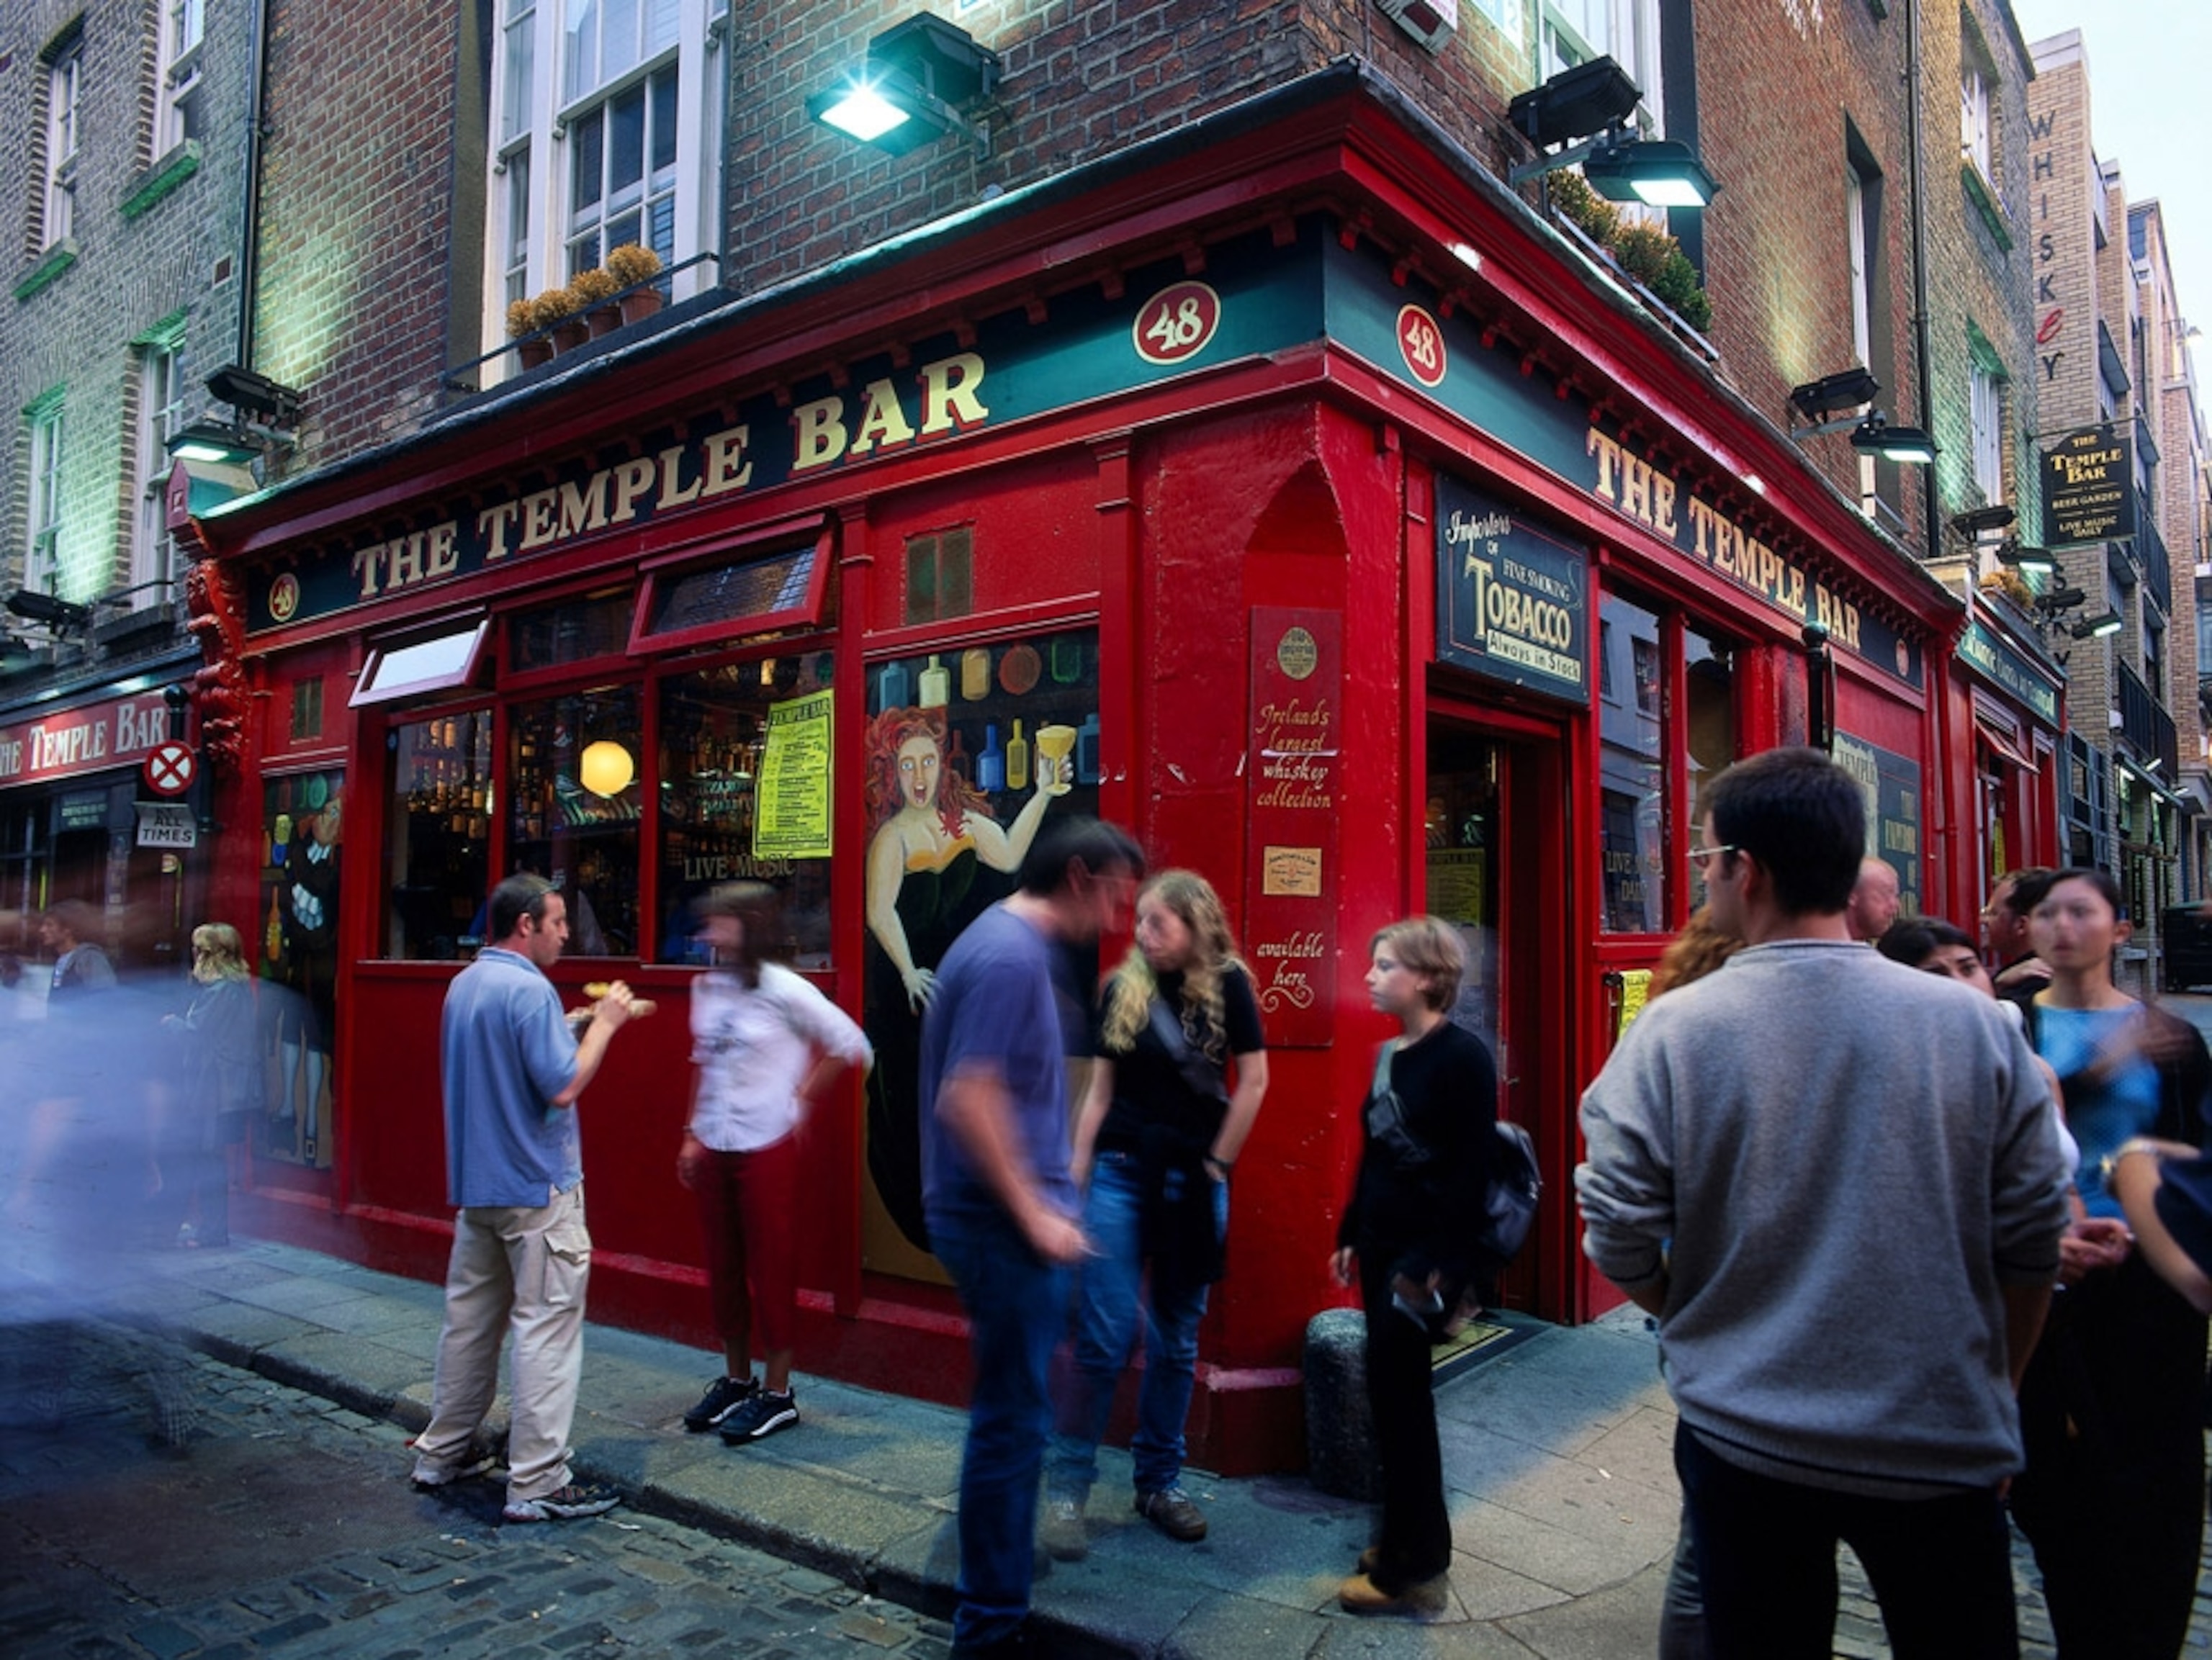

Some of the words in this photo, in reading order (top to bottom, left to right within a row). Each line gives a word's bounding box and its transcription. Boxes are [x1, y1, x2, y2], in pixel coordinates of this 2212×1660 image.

[1146, 296, 1203, 352] 48
[1406, 316, 1437, 370] 48
[2072, 434, 2098, 448] THE
[2050, 448, 2123, 471] TEMPLE
[353, 519, 459, 597] THE
[478, 424, 754, 561] TEMPLE
[791, 352, 989, 472] BAR
[2067, 466, 2106, 484] BAR
[1586, 425, 1677, 543] THE
[1688, 494, 1807, 617] TEMPLE
[1815, 583, 1861, 650] BAR
[1465, 553, 1572, 651] TOBACCO
[1490, 631, 1529, 662] Always
[1549, 651, 1578, 679] Stock
[30, 721, 107, 771] TEMPLE
[114, 703, 166, 754] BAR
[1256, 781, 1331, 808] collection
[143, 828, 192, 843] TIMES
[154, 816, 183, 828] ALL
[684, 857, 728, 883] LIVE
[1256, 931, 1324, 958] available
[1272, 959, 1308, 987] here
